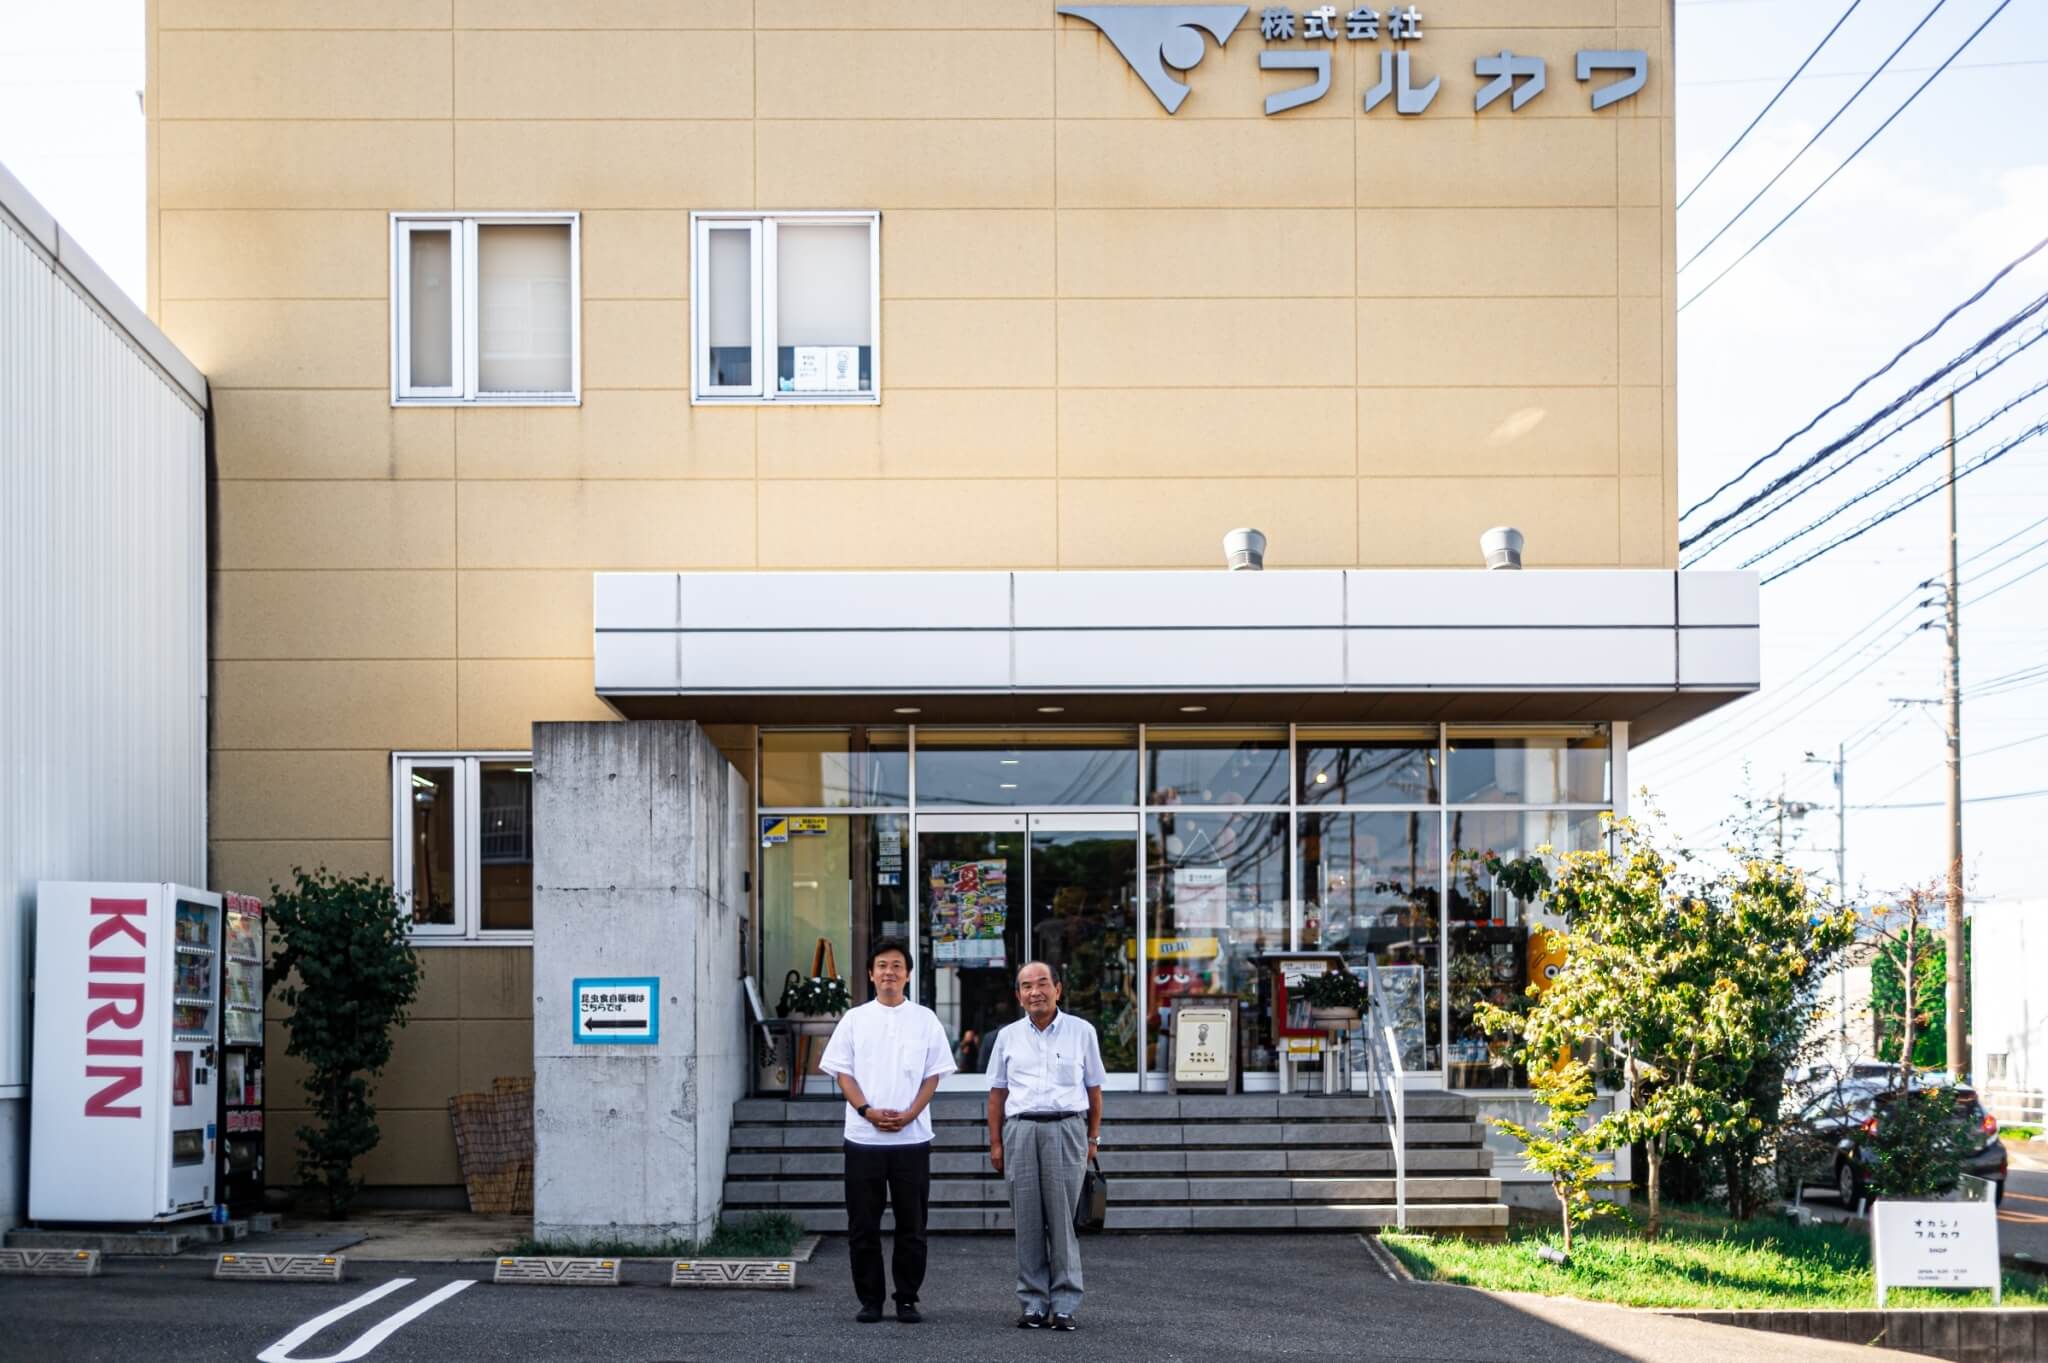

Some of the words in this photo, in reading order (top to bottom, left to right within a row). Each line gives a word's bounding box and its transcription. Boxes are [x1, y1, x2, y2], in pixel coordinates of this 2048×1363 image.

[1260, 5, 1424, 41] 株式会社
[1258, 49, 1650, 116] フルカワ
[84, 897, 148, 1119] KIRIN
[581, 994, 645, 1003] 昆虫食自販機は
[1915, 1231, 1960, 1239] フルカワ
